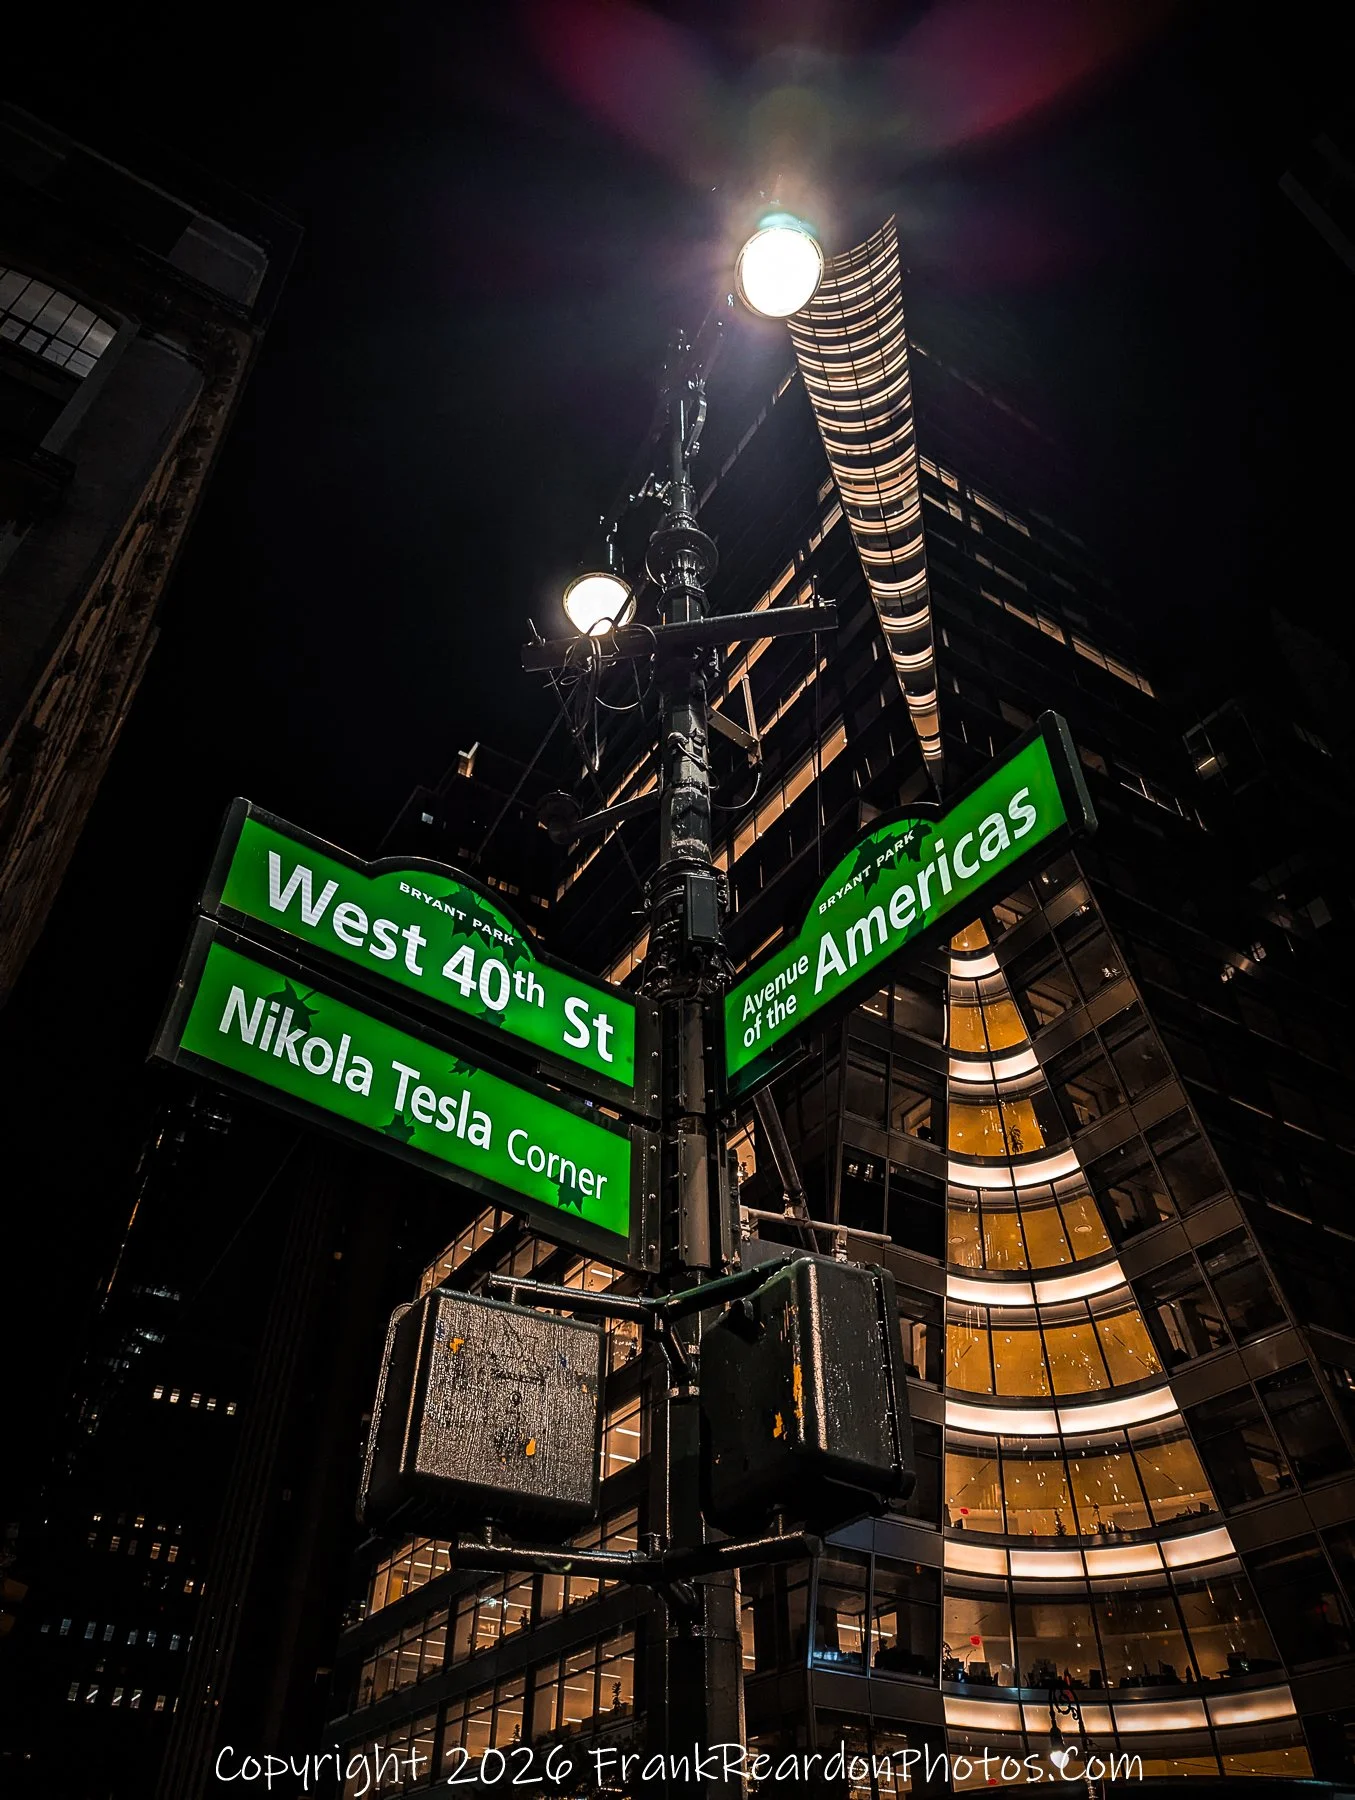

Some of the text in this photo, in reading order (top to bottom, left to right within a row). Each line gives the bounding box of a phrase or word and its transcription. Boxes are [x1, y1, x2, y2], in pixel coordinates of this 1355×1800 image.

[399, 881, 516, 947] BRYANT PARK
[813, 786, 1038, 996] Americas
[818, 829, 916, 915] BRYANT PARK
[268, 850, 615, 1063] West 40th St
[742, 953, 810, 1022] Avenue
[743, 993, 798, 1049] of the
[218, 985, 609, 1201] Nikola Tesla Corner
